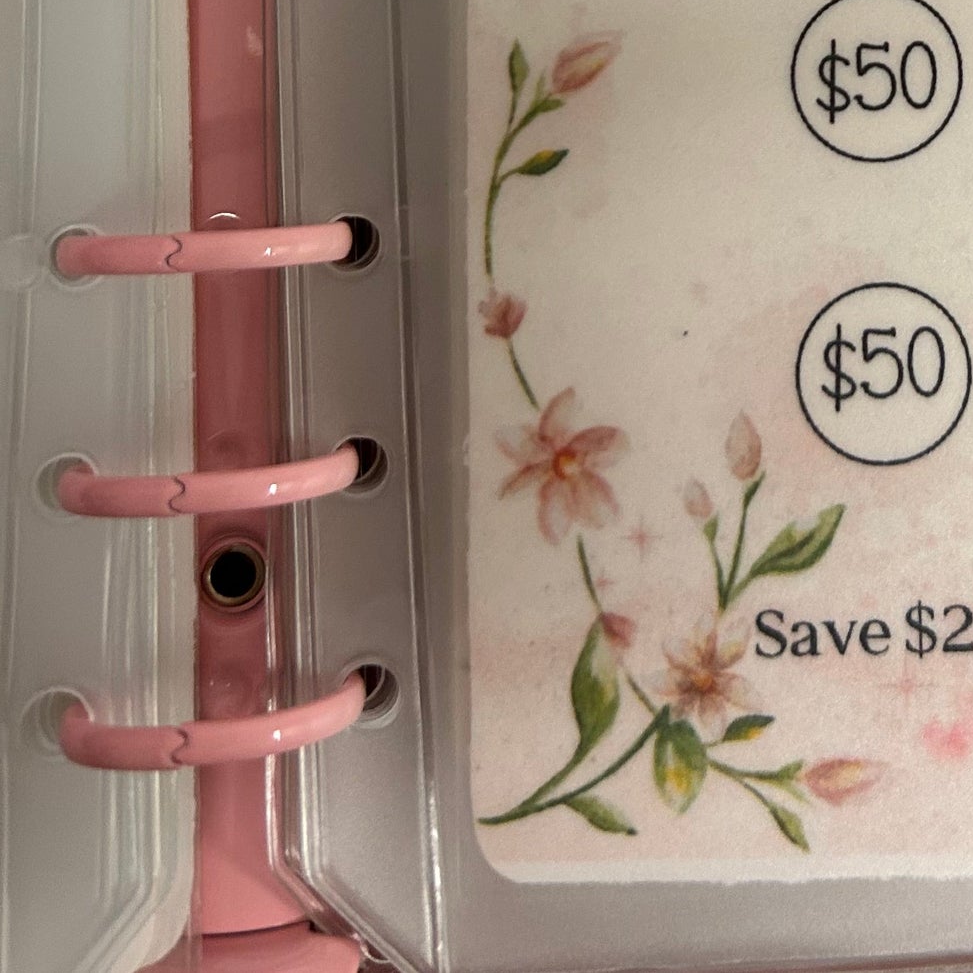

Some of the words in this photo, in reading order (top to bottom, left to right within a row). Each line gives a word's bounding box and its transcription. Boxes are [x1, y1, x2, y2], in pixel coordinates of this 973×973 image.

[815, 38, 938, 125] $50
[820, 322, 946, 414] $50
[754, 608, 892, 660] Save
